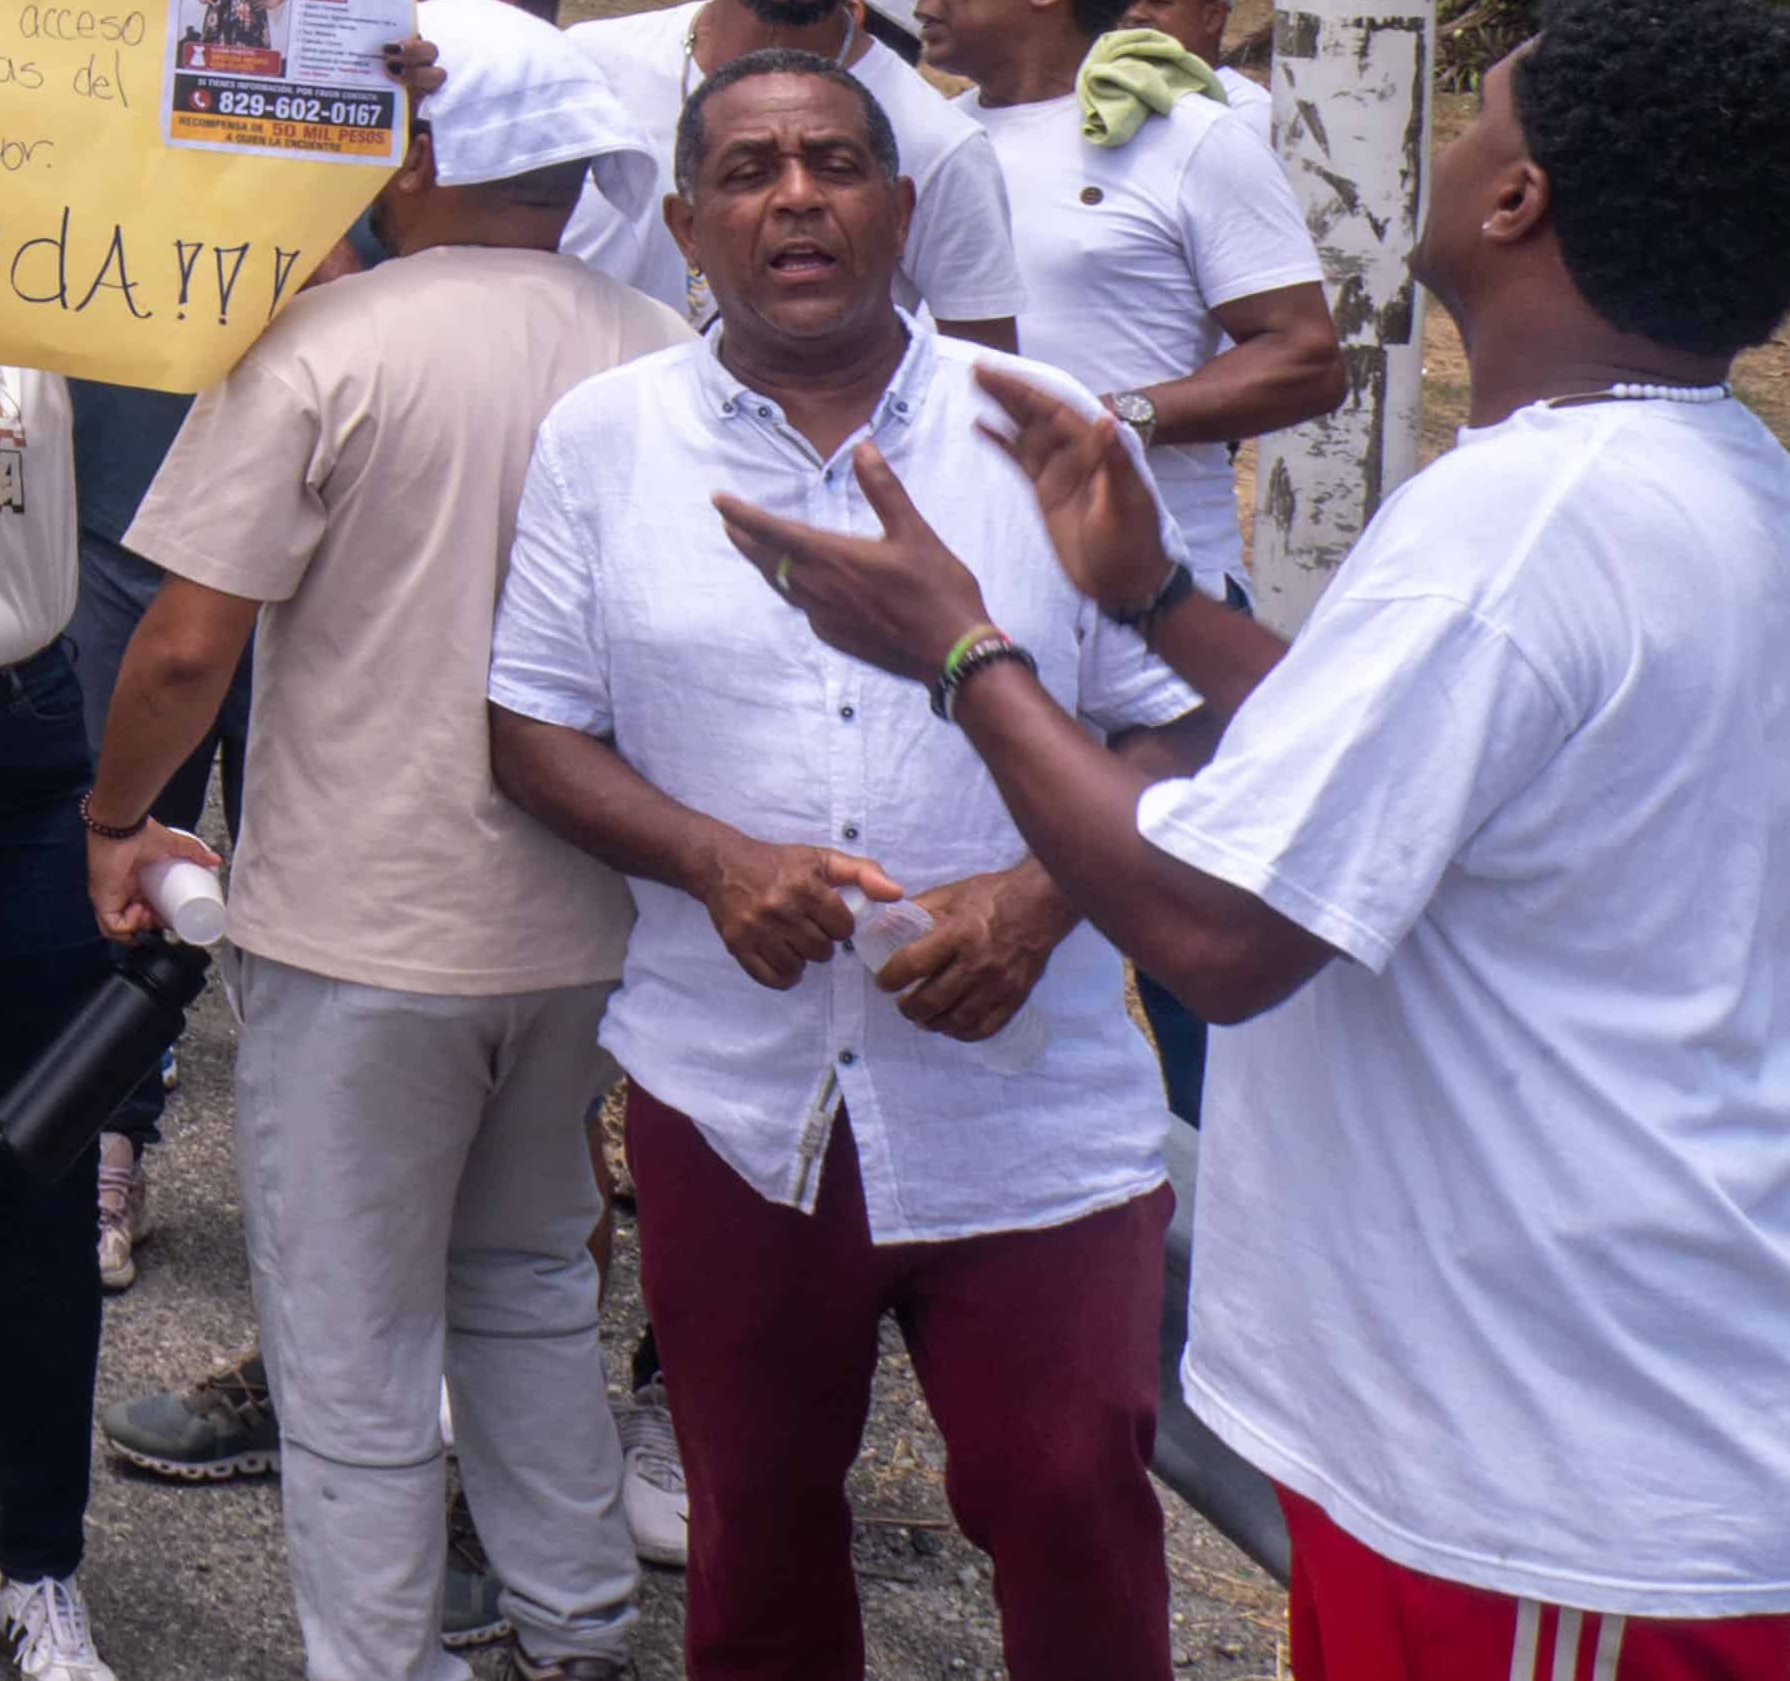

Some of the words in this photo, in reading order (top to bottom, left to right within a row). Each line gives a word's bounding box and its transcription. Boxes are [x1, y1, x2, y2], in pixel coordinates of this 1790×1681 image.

[19, 4, 145, 46] acceso
[73, 49, 128, 108] del
[219, 91, 382, 127] 829-602-0167
[272, 122, 296, 137] 50
[303, 125, 335, 142] MIL
[338, 128, 385, 144] PESOS
